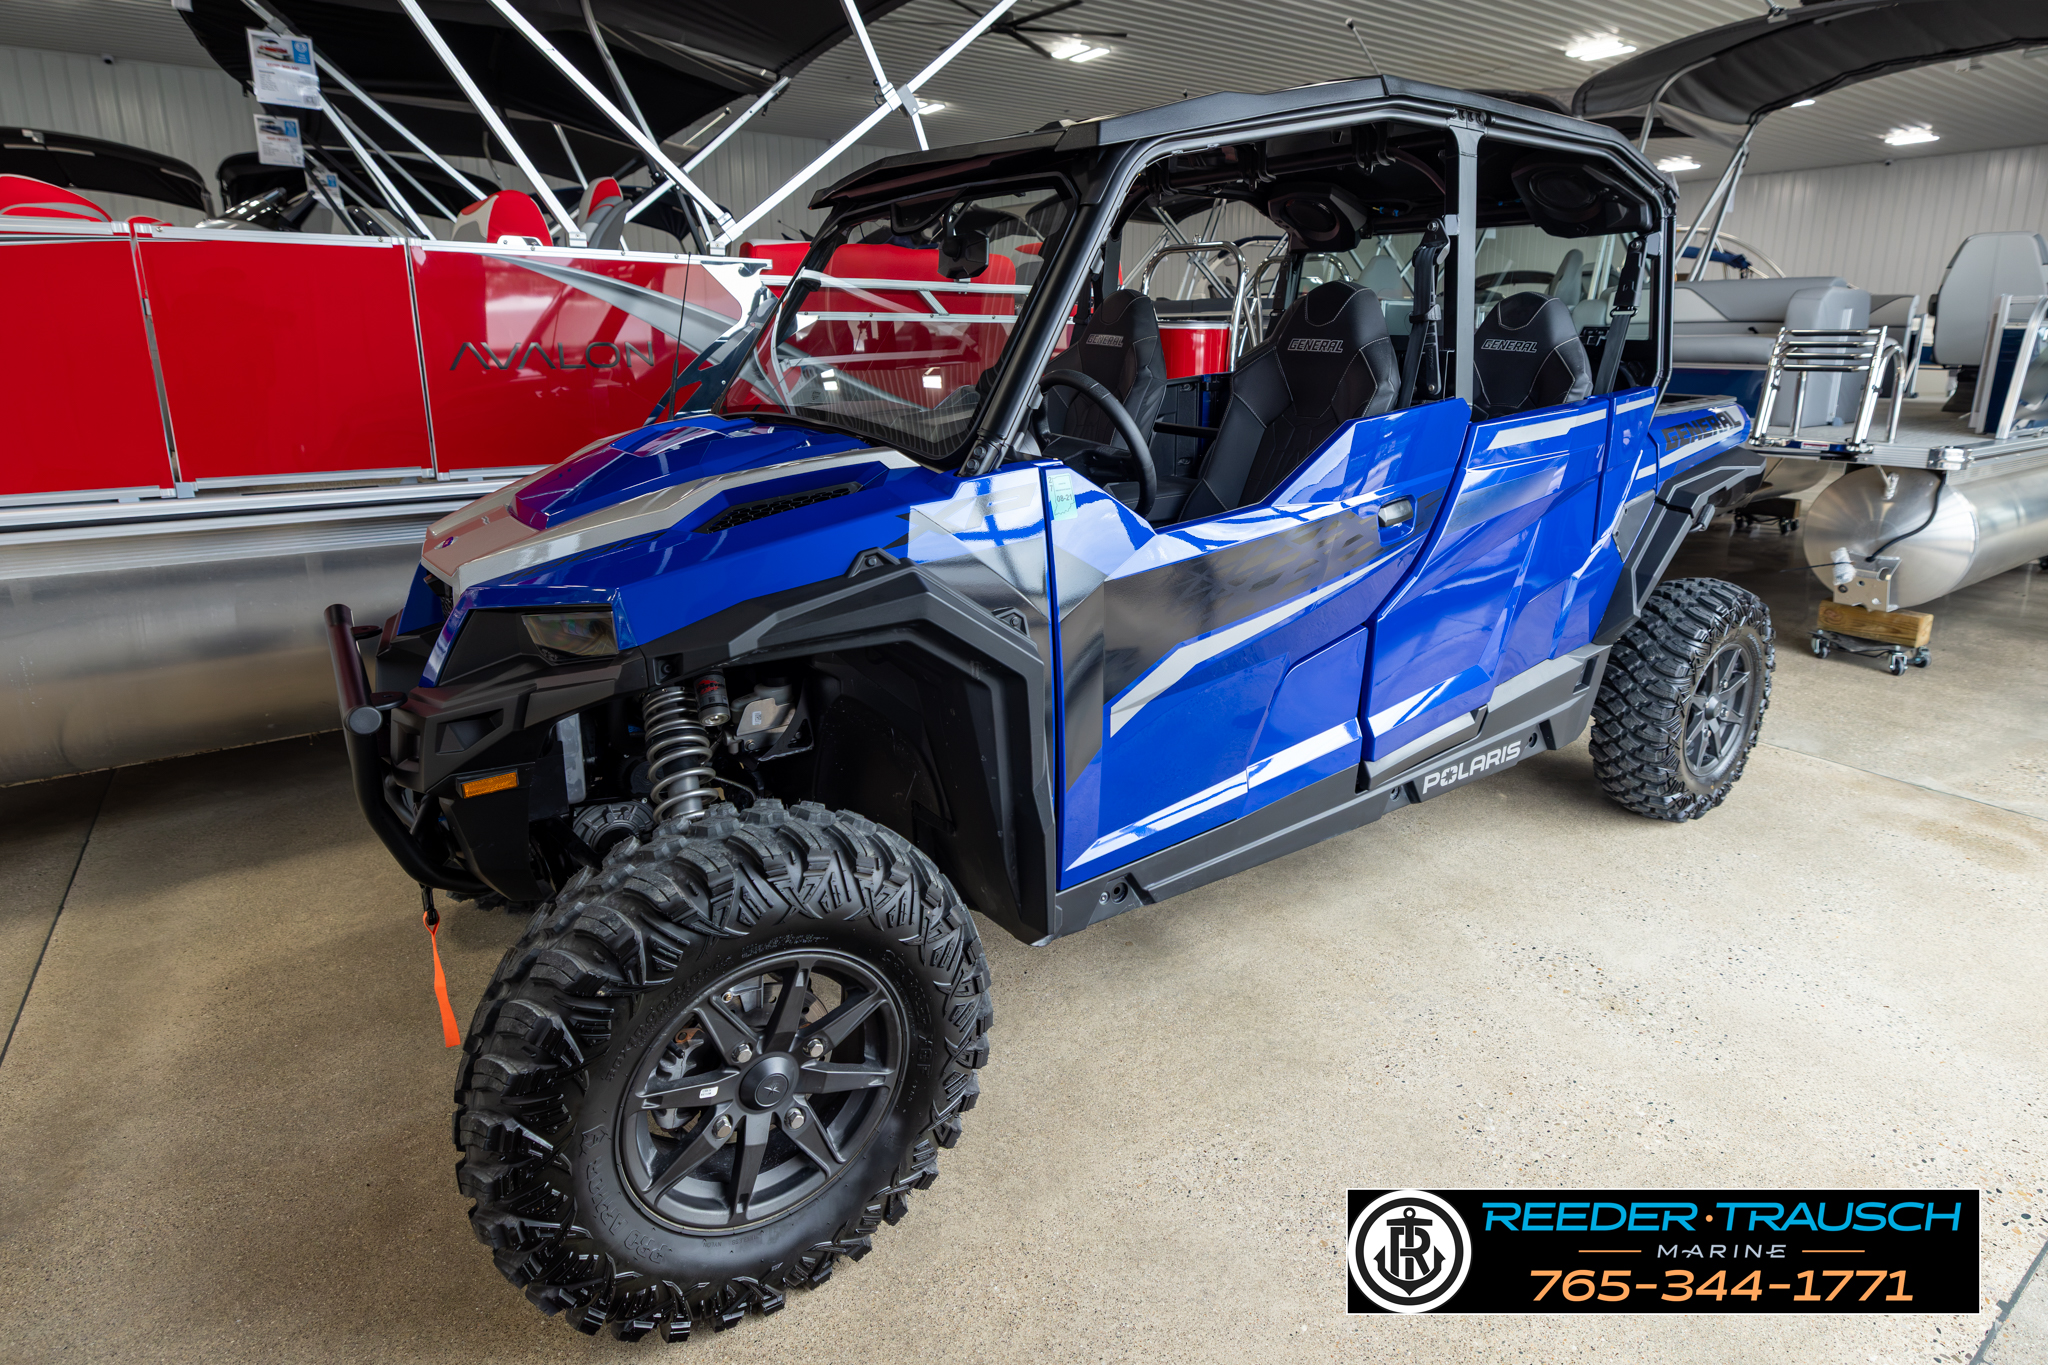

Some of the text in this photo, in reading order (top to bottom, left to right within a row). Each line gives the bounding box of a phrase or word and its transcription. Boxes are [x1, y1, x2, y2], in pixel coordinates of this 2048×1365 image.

[1086, 333, 1124, 348] GENERAL
[1287, 337, 1344, 353] GENERAL
[1481, 338, 1538, 353] GENERAL
[449, 341, 655, 371] AVALON
[1661, 410, 1742, 452] GENERAL
[1056, 494, 1073, 502] 08-21
[1422, 740, 1522, 794] POLARIS
